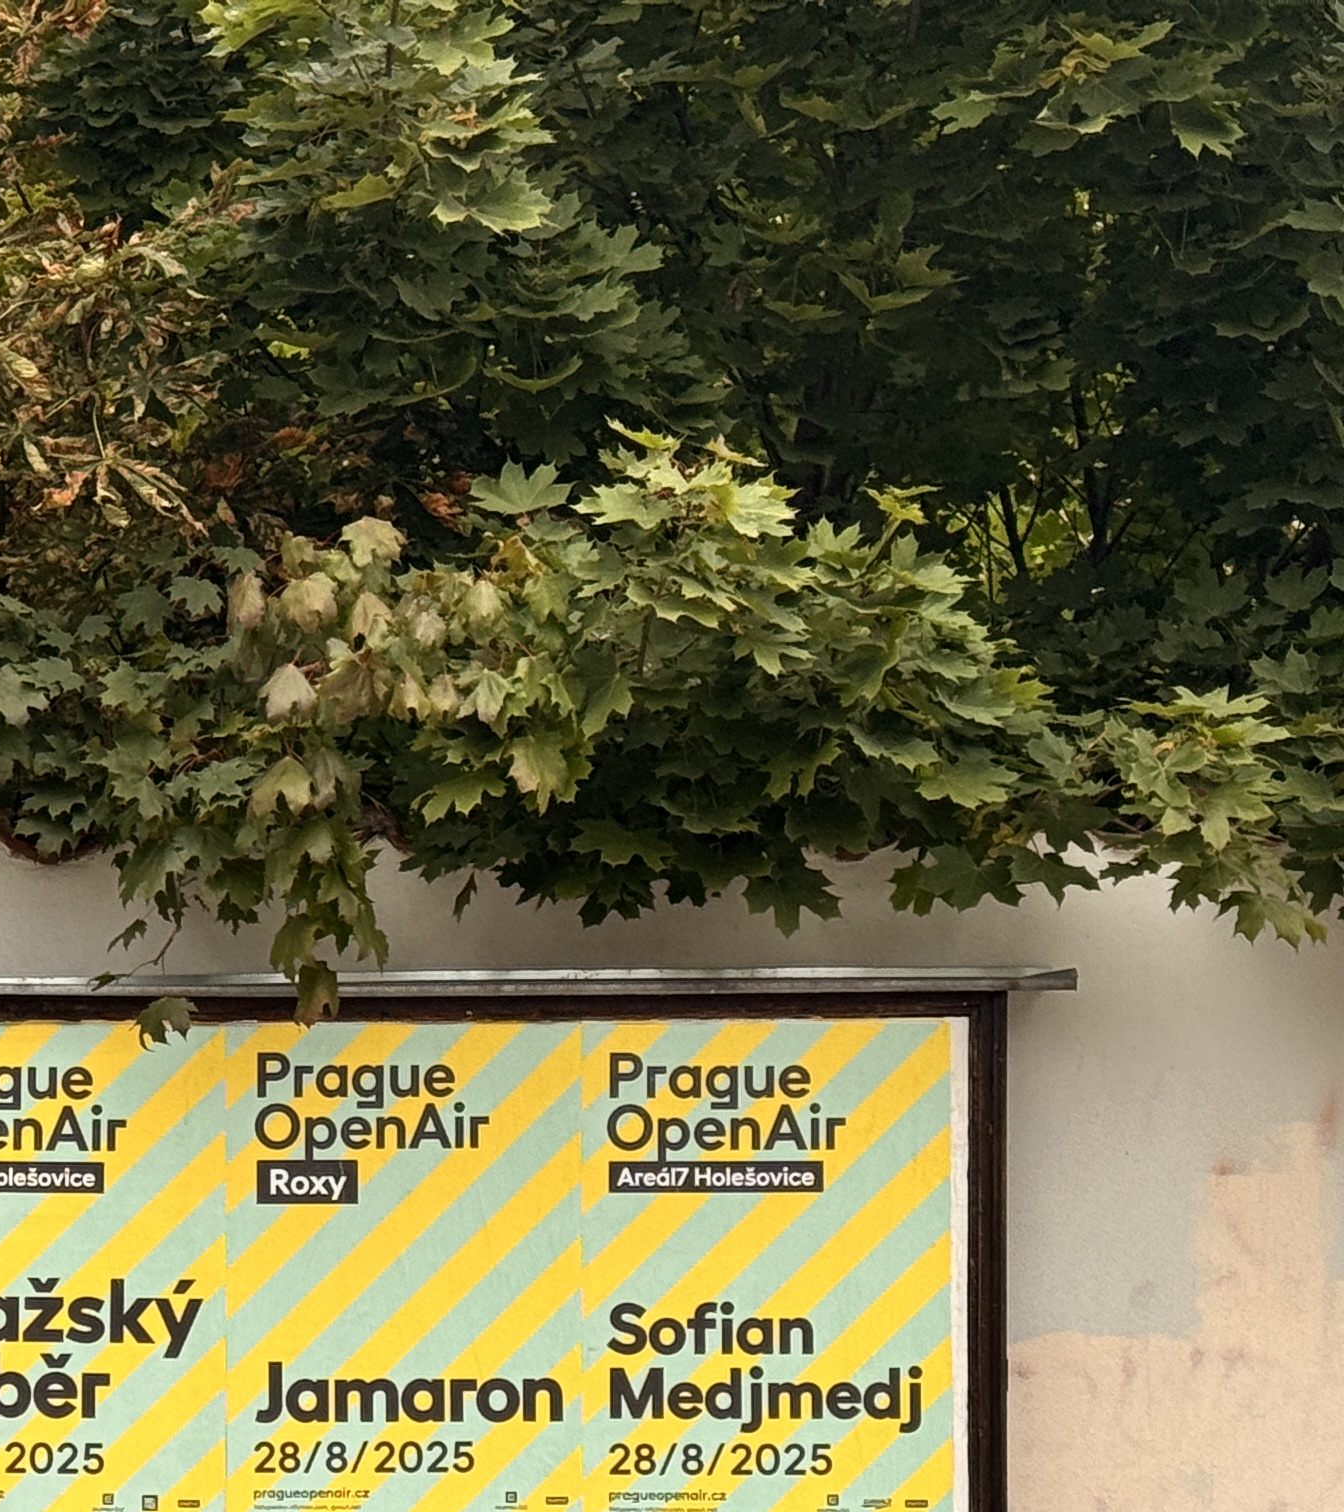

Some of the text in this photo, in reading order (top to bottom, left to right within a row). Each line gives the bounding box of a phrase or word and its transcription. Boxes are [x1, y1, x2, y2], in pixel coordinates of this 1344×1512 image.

[257, 1052, 455, 1109] Prague
[609, 1052, 811, 1110] Prague
[254, 1102, 490, 1161] OpenAir
[607, 1103, 846, 1162] OpenAir
[269, 1169, 347, 1200] Roxy
[617, 1167, 815, 1188] Areál7 Holešovice
[607, 1301, 814, 1355] Sofian
[255, 1361, 563, 1423] Jamaron
[609, 1365, 923, 1433] Medjmedj
[254, 1440, 475, 1474] 28/8/2025
[608, 1443, 833, 1477] 28/8/2025
